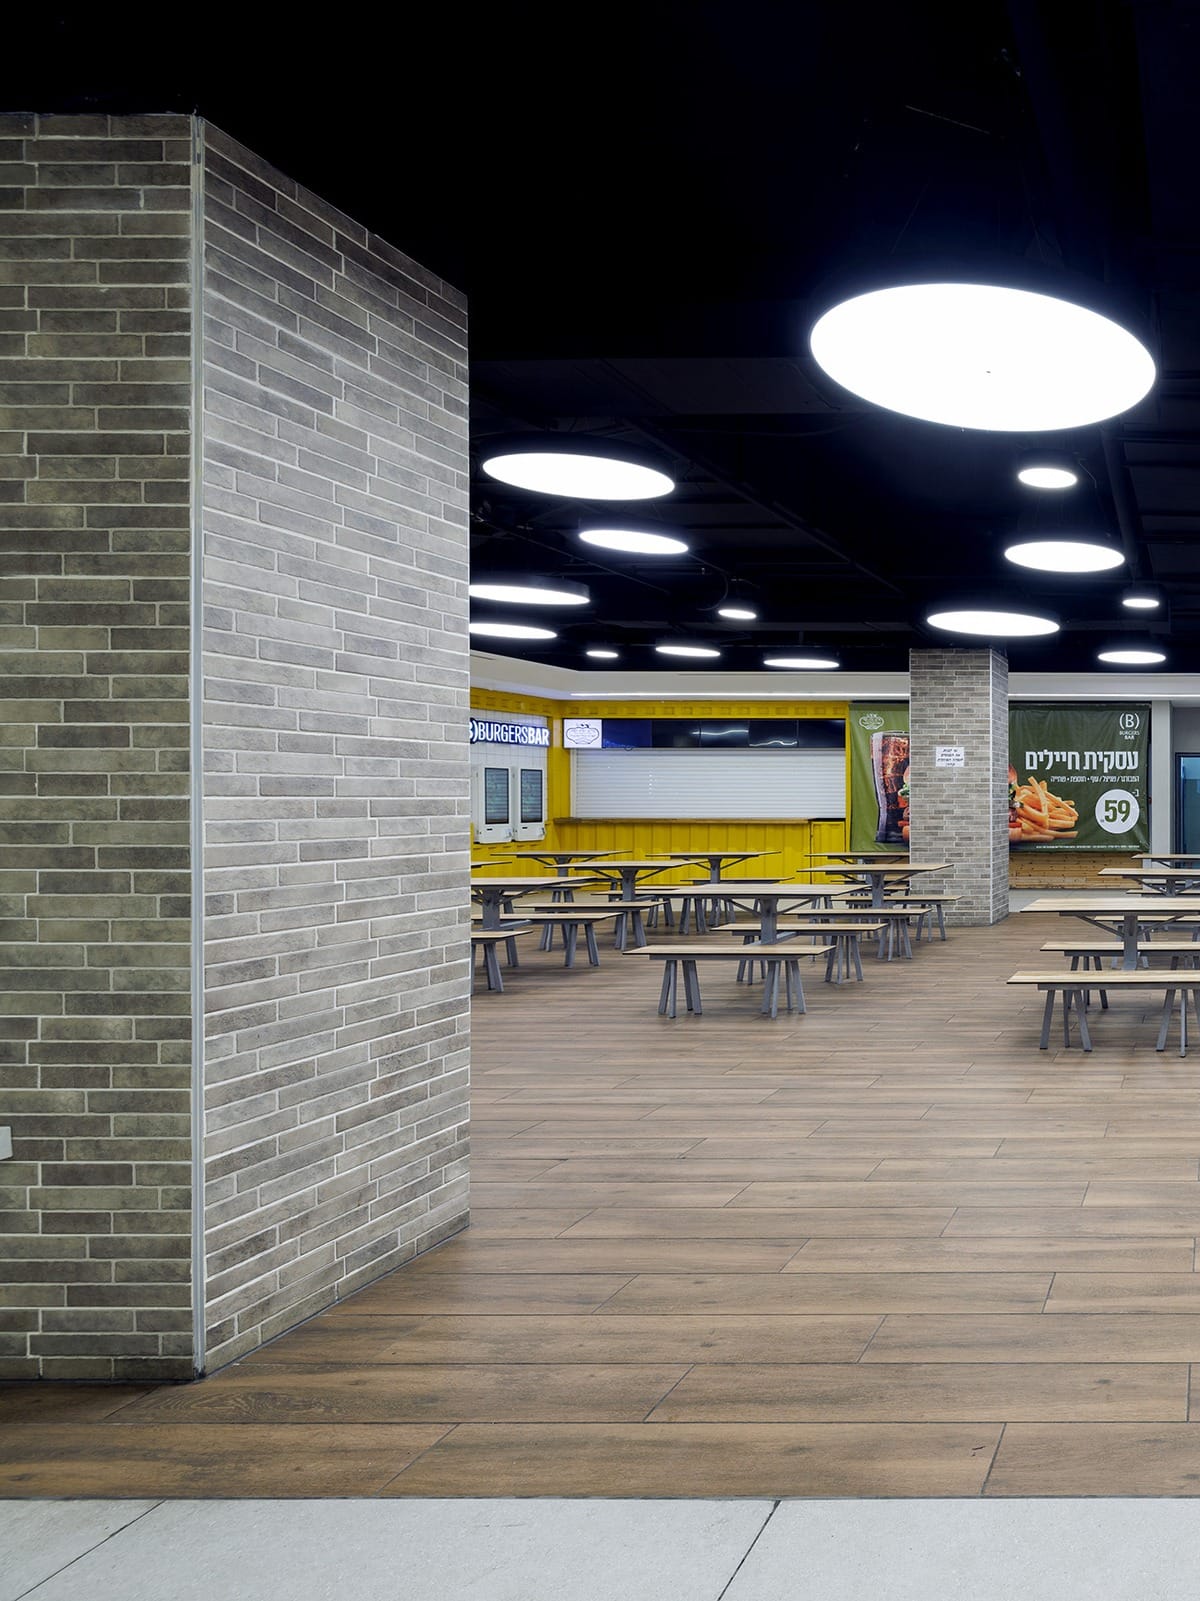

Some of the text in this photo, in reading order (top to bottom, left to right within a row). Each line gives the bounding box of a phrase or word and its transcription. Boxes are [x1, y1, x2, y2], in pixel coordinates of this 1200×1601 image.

[479, 721, 550, 746] BURGERSBAR
[1025, 749, 1139, 773] עסקית חיילים
[1104, 799, 1131, 823] 59
